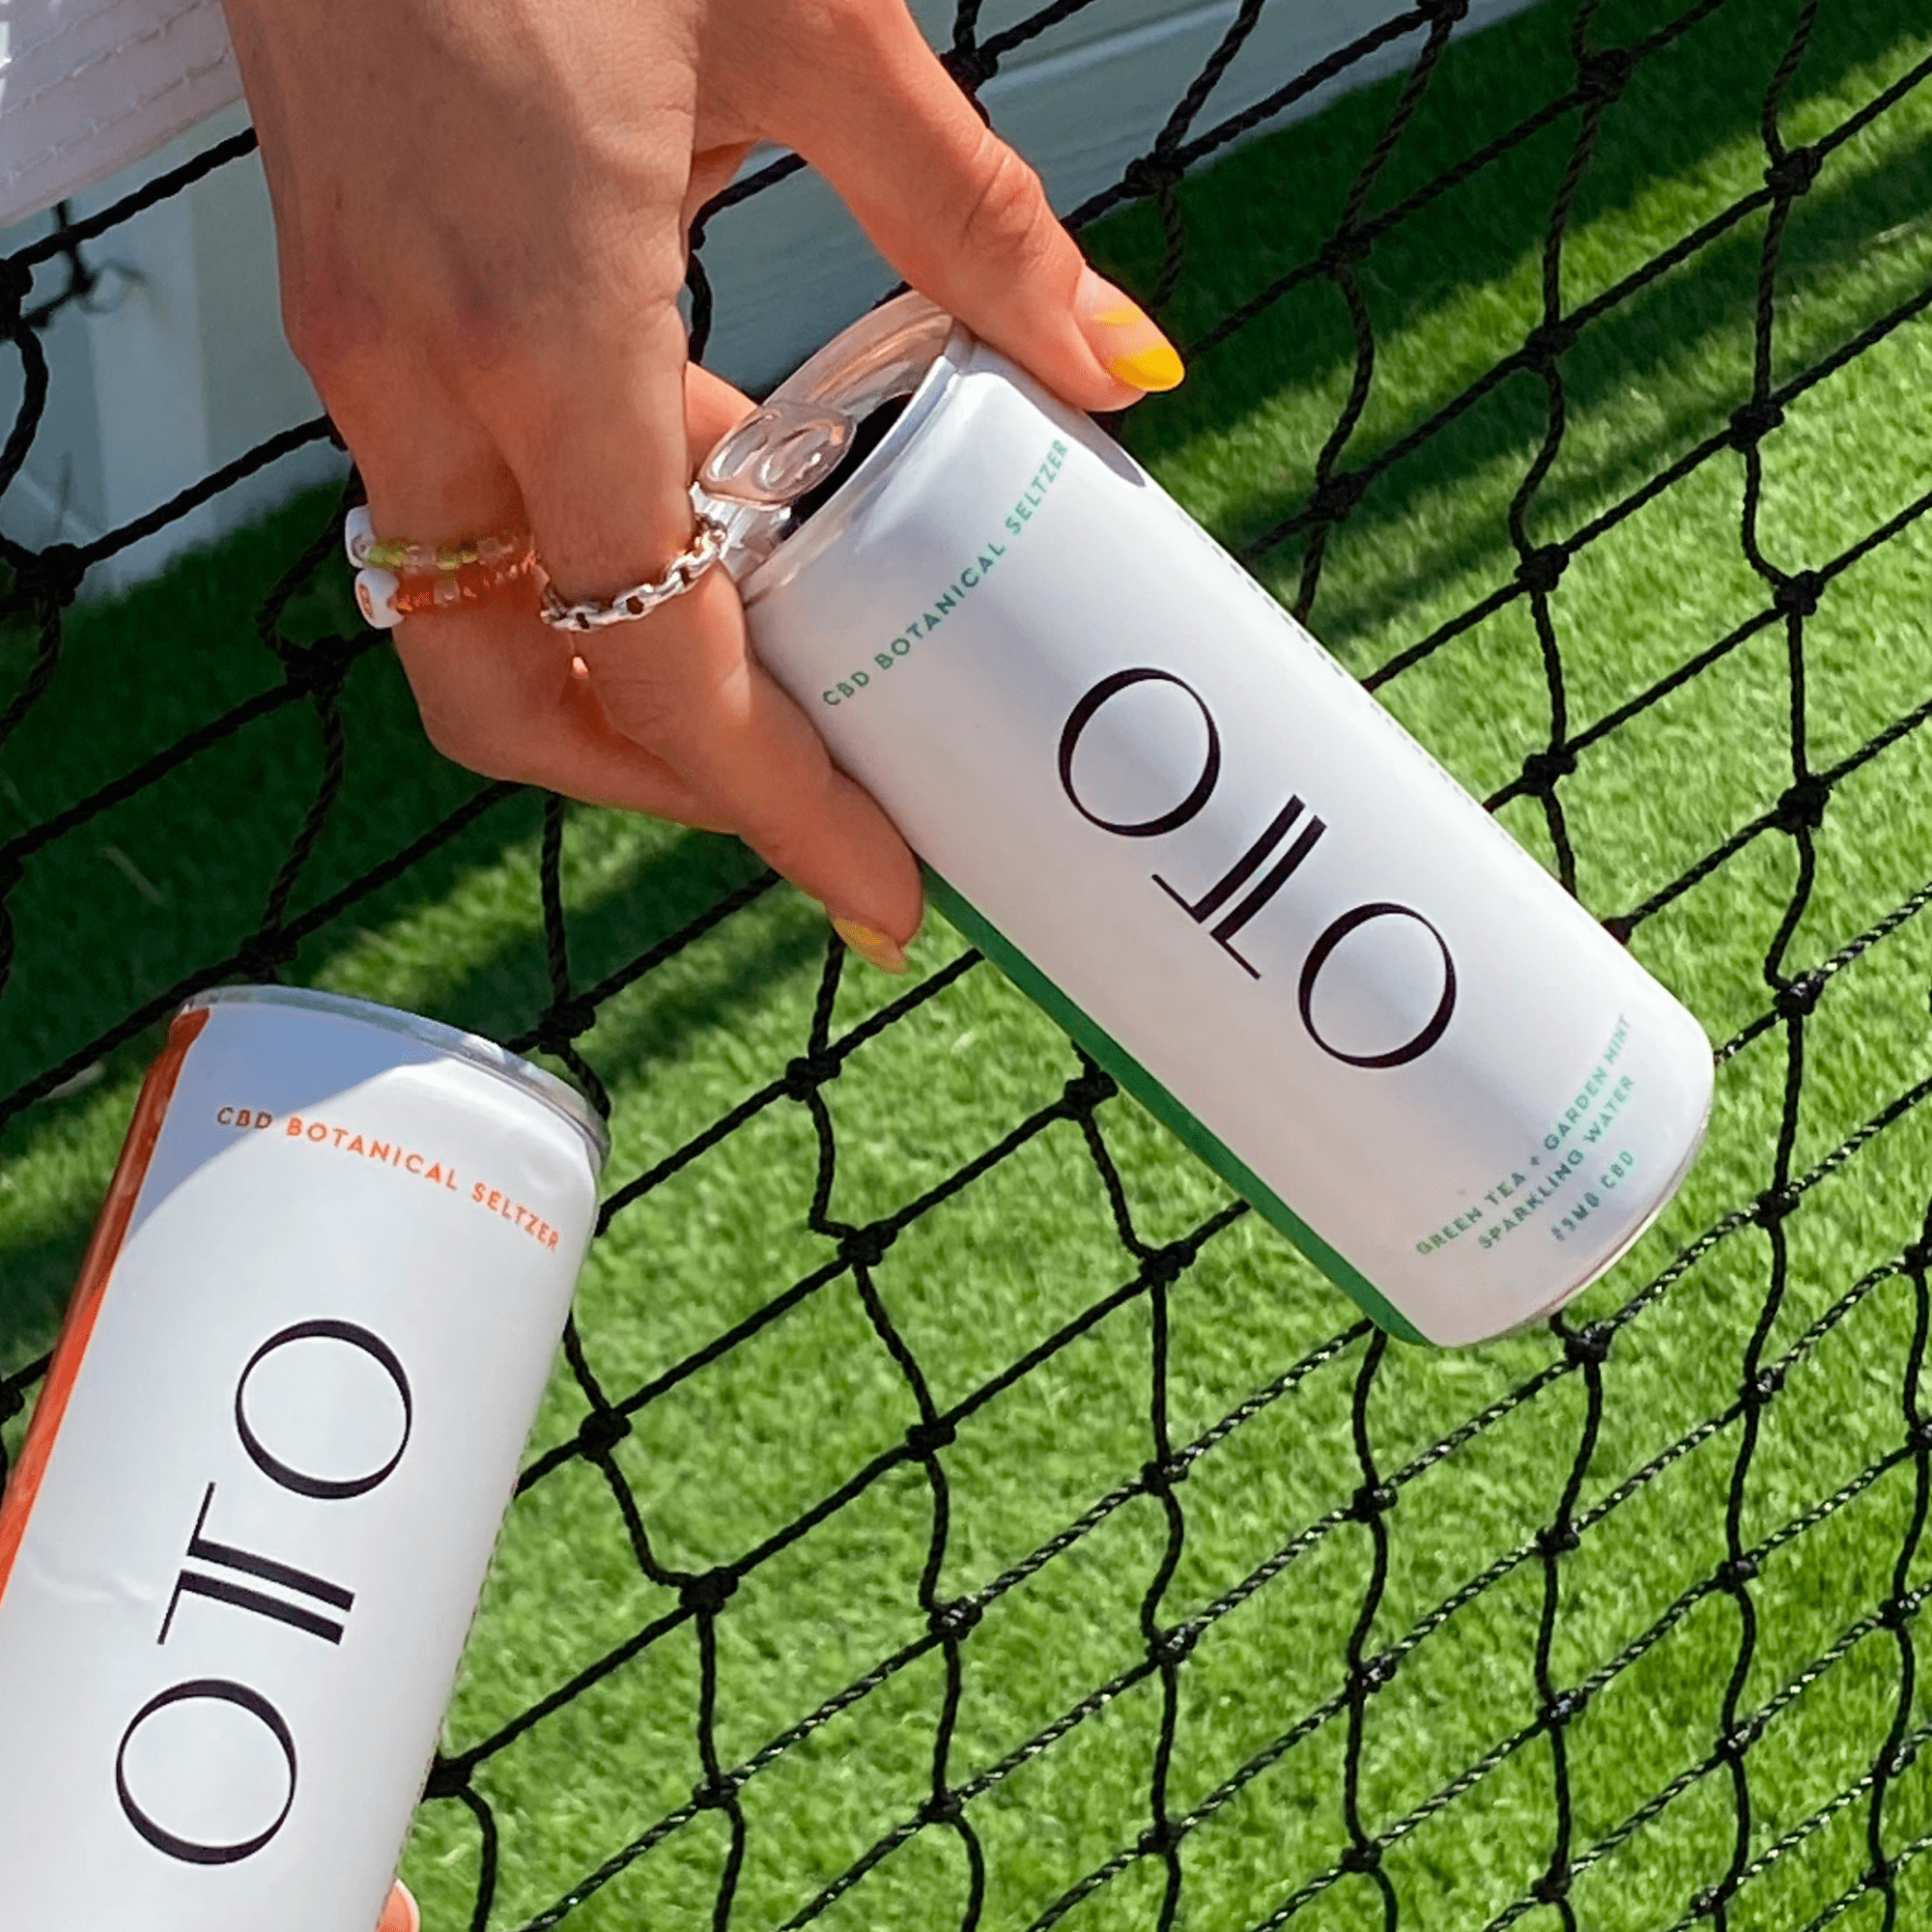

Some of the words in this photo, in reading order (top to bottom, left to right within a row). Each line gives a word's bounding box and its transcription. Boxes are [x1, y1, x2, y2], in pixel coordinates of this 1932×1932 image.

[822, 671, 870, 706] CBD
[874, 543, 1007, 670] BOTANICAL
[1005, 440, 1068, 535] SELTZER
[1058, 668, 1457, 1069] OTTO
[215, 1106, 274, 1130] CBD
[286, 1116, 459, 1192] BOTANICAL
[470, 1180, 560, 1255] SELTZER
[1415, 1207, 1484, 1255] GREEN
[1484, 1172, 1526, 1207] TEA
[1544, 1066, 1609, 1151] GARDEN
[1603, 1012, 1632, 1065] MINT
[1478, 1149, 1585, 1250] SPARKLING
[1583, 1074, 1635, 1144] WATER
[1600, 1150, 1634, 1189] CBD
[115, 1320, 412, 1865] OTTO
